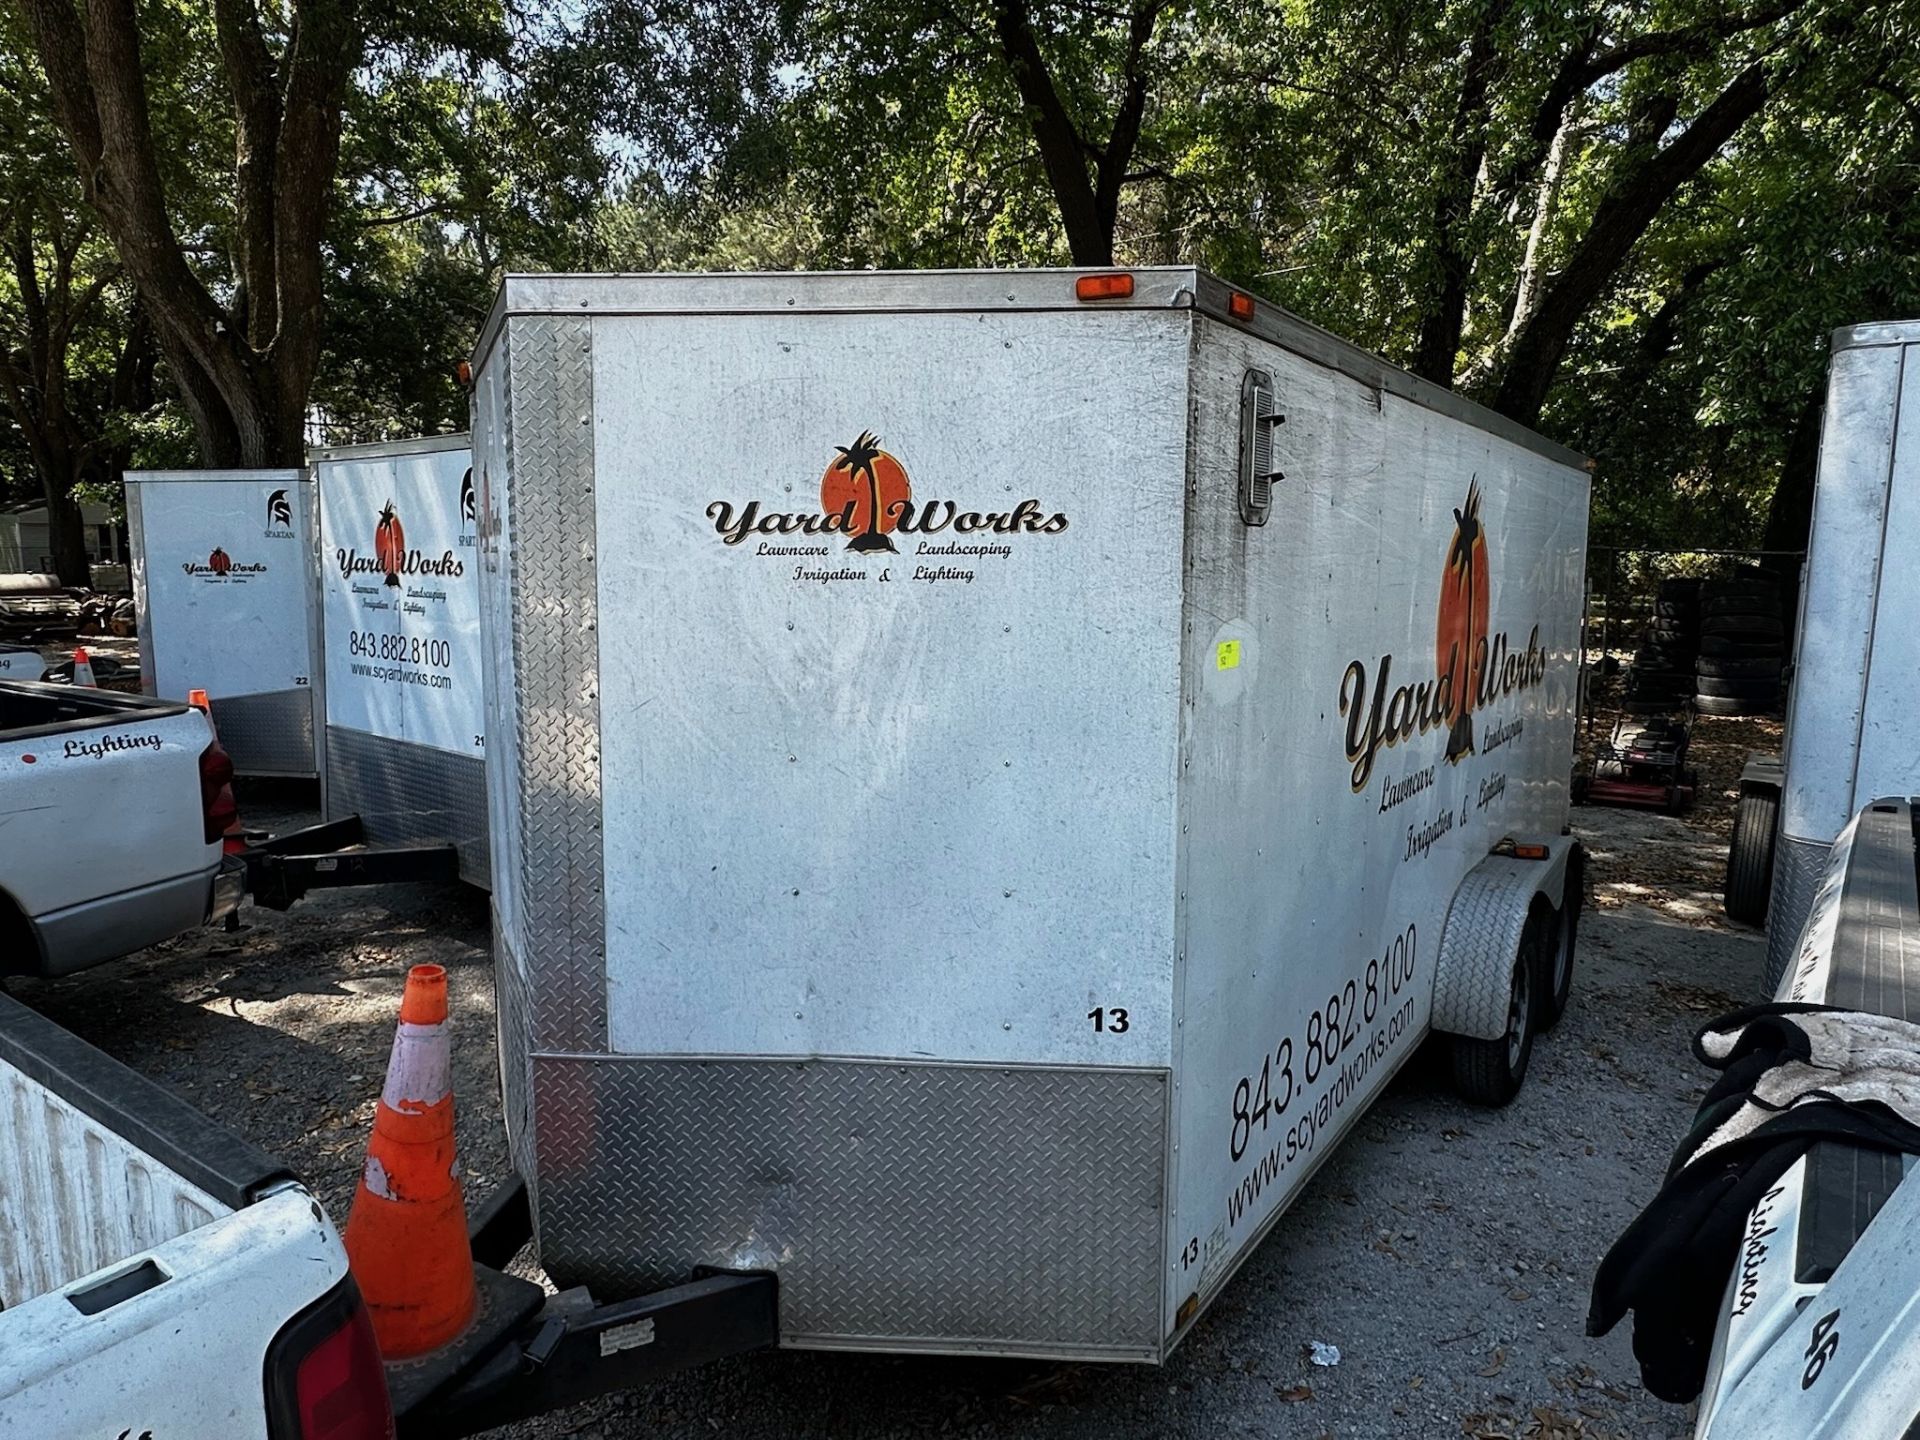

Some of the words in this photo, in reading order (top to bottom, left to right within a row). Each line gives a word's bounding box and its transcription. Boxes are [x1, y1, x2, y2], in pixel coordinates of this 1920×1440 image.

[705, 499, 859, 546] Yard
[887, 498, 1069, 536] Works
[337, 548, 387, 579] Yard
[398, 549, 464, 577] Works
[755, 541, 829, 557] Lawncare
[914, 540, 1012, 558] Landscaping
[792, 566, 867, 584] Irrigation
[879, 568, 890, 583] &
[911, 566, 975, 584] Lighting
[350, 630, 451, 668] 843.882.8100
[295, 676, 309, 685] 22
[351, 662, 452, 690] www.scyardworks.com
[1339, 640, 1459, 794] Yard
[1474, 623, 1546, 710] Works
[64, 733, 164, 759] Lighting
[474, 735, 485, 746] 21
[1378, 765, 1436, 814] Lawncare
[1402, 808, 1454, 862] Irrigation
[1087, 1007, 1130, 1034] 13
[1229, 922, 1417, 1163] 843.882.8100
[1227, 996, 1415, 1228] www.scyardworks.com
[1181, 1236, 1198, 1271] 13
[1801, 1308, 1841, 1391] 46
